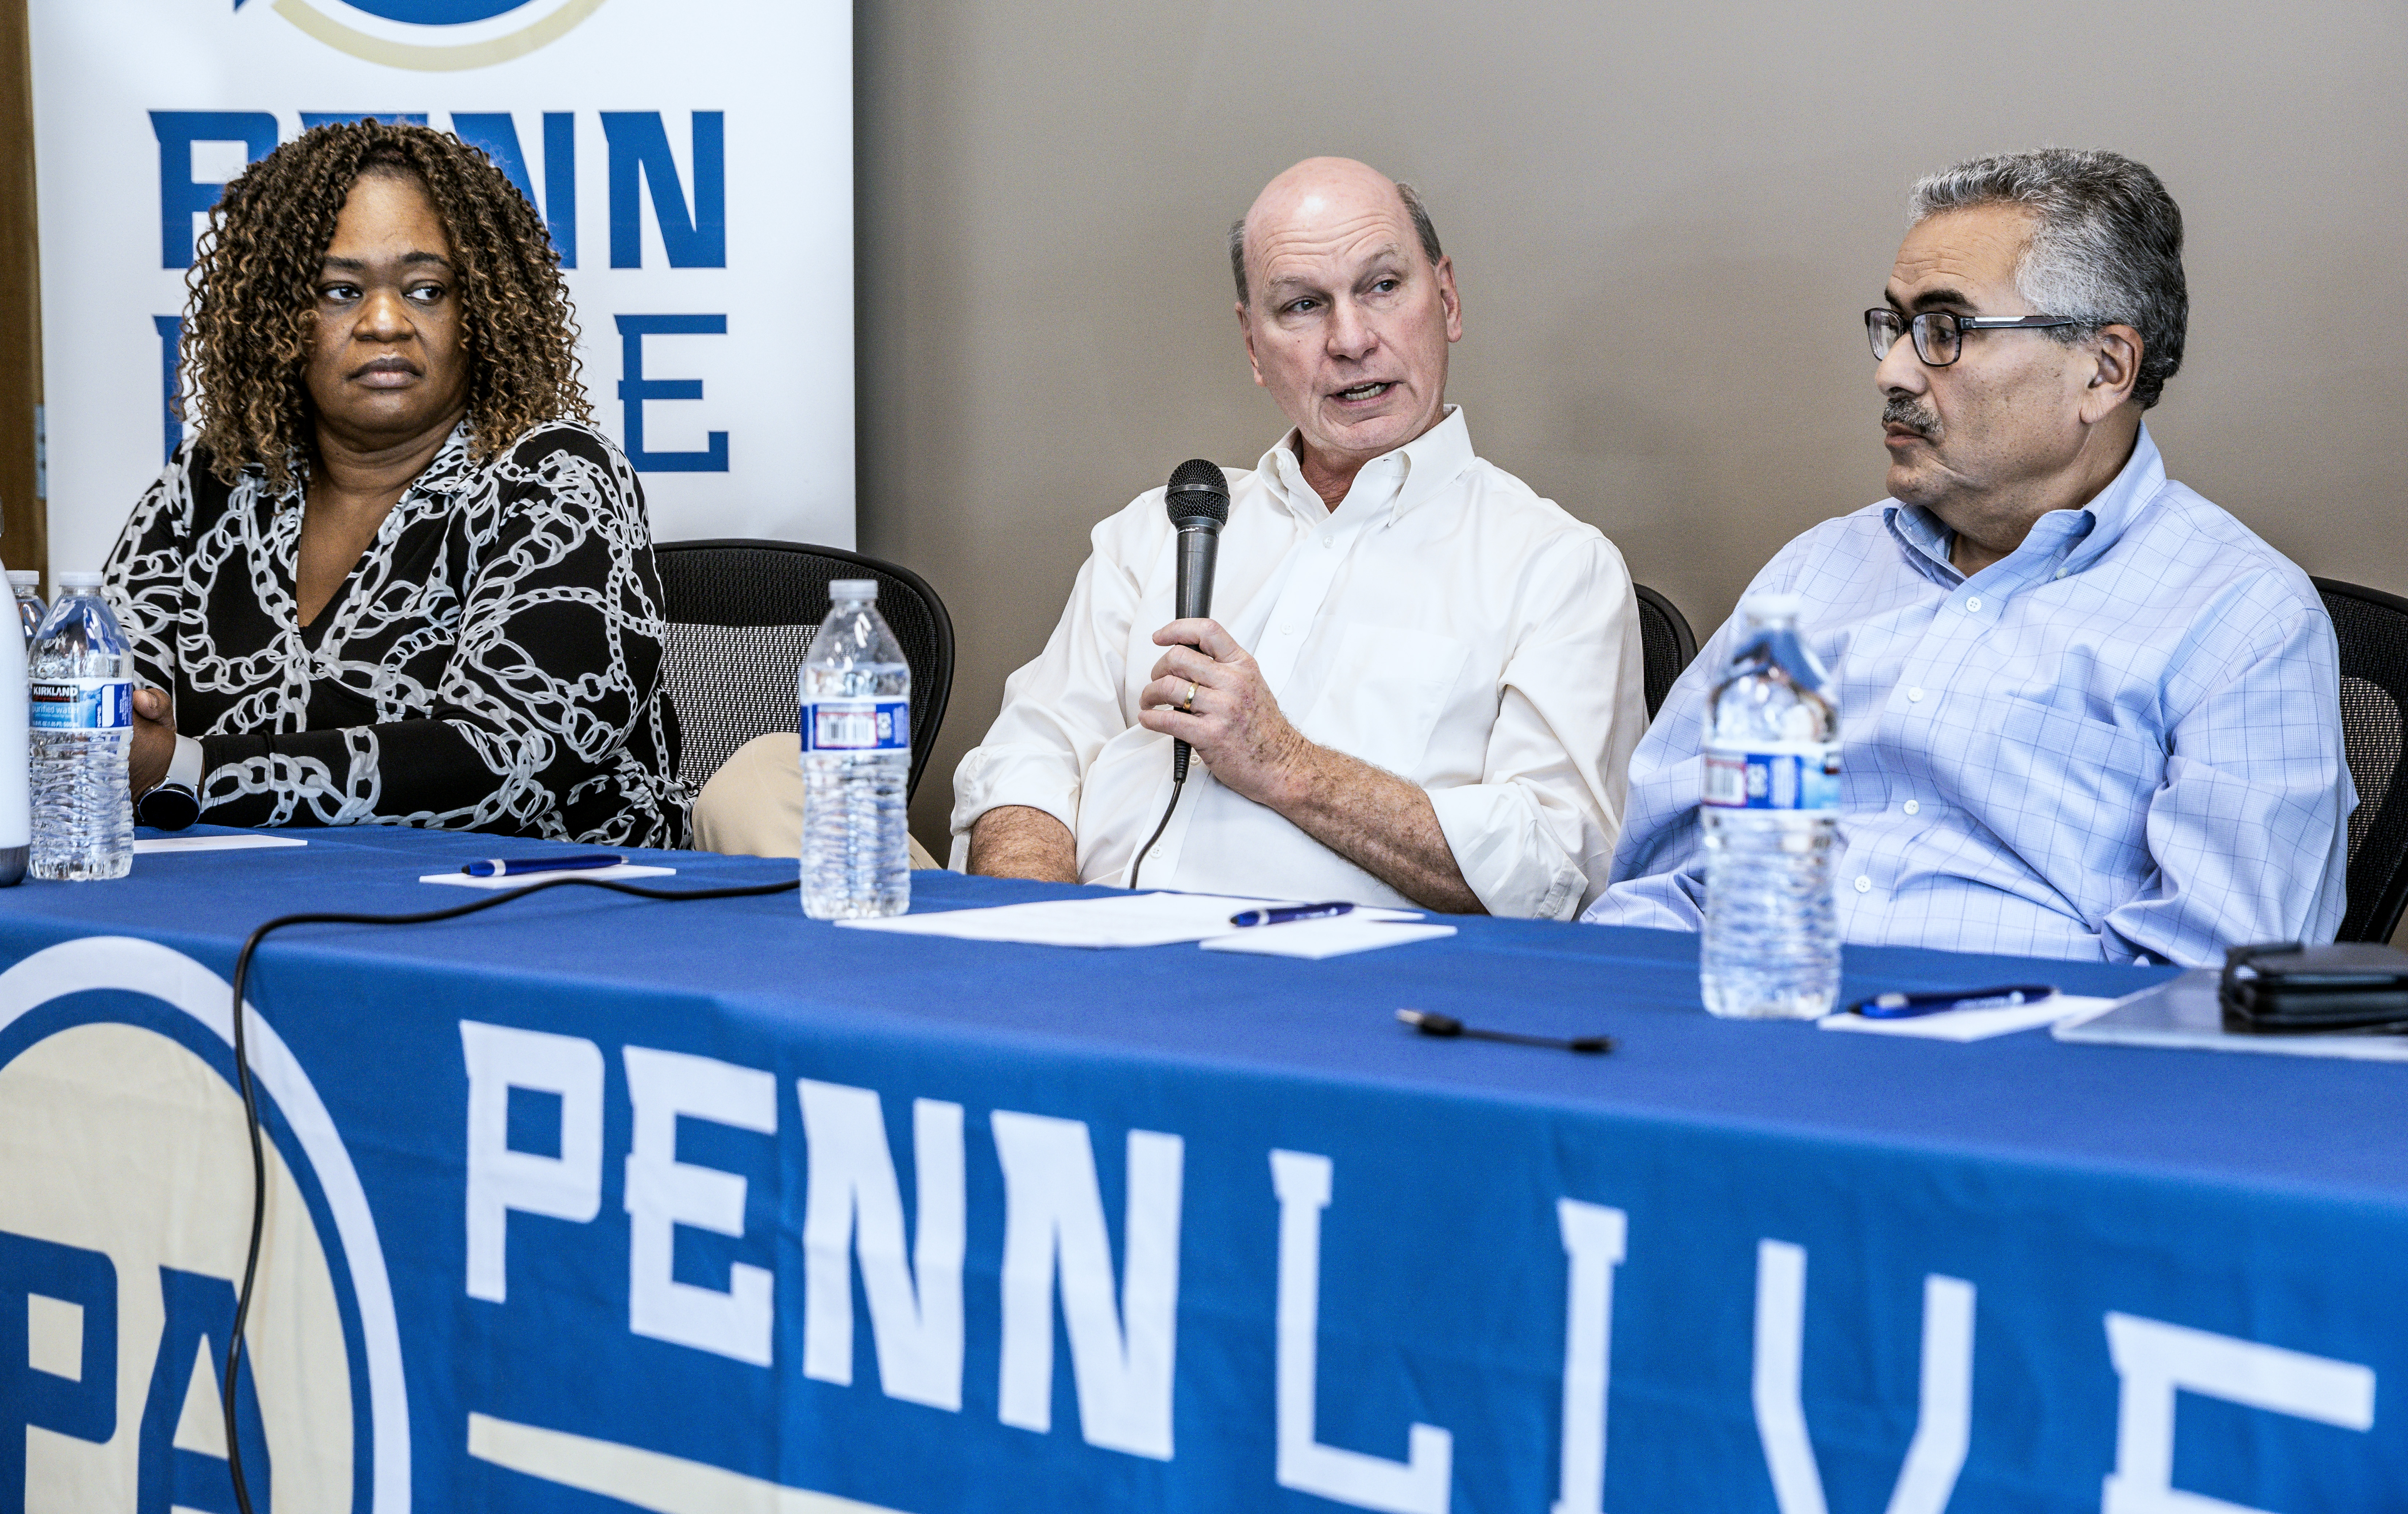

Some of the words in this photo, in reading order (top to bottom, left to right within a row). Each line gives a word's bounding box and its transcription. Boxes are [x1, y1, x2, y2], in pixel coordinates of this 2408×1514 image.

[147, 109, 727, 269] PNN
[33, 686, 78, 697] KIRKLAND
[459, 1019, 1184, 1461] PENN
[0, 1229, 272, 1514] PA
